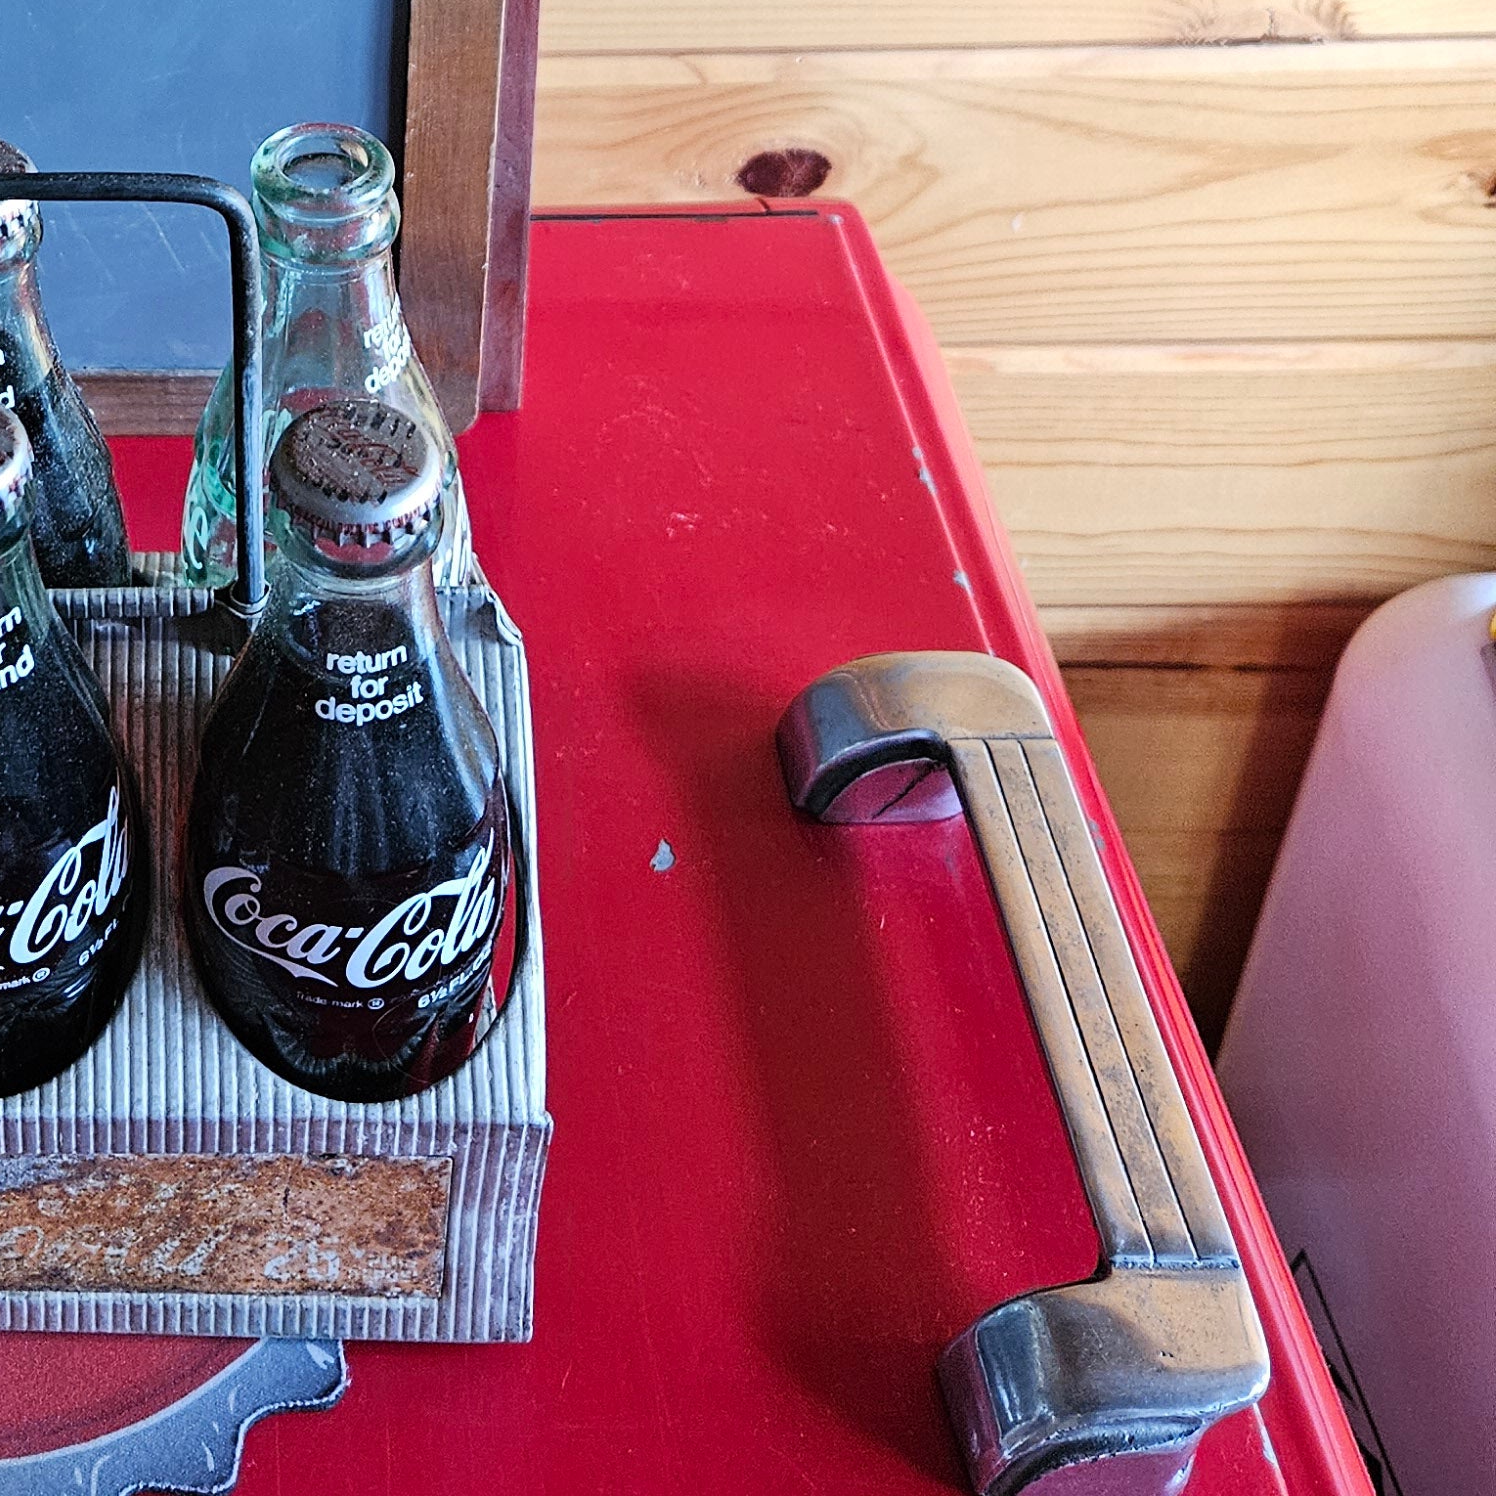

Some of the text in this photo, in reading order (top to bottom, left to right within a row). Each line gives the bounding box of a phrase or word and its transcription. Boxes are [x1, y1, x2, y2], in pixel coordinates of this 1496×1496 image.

[326, 644, 408, 676] return
[315, 680, 424, 727] deposit
[350, 675, 390, 699] for
[204, 826, 496, 989] Coca-Cola
